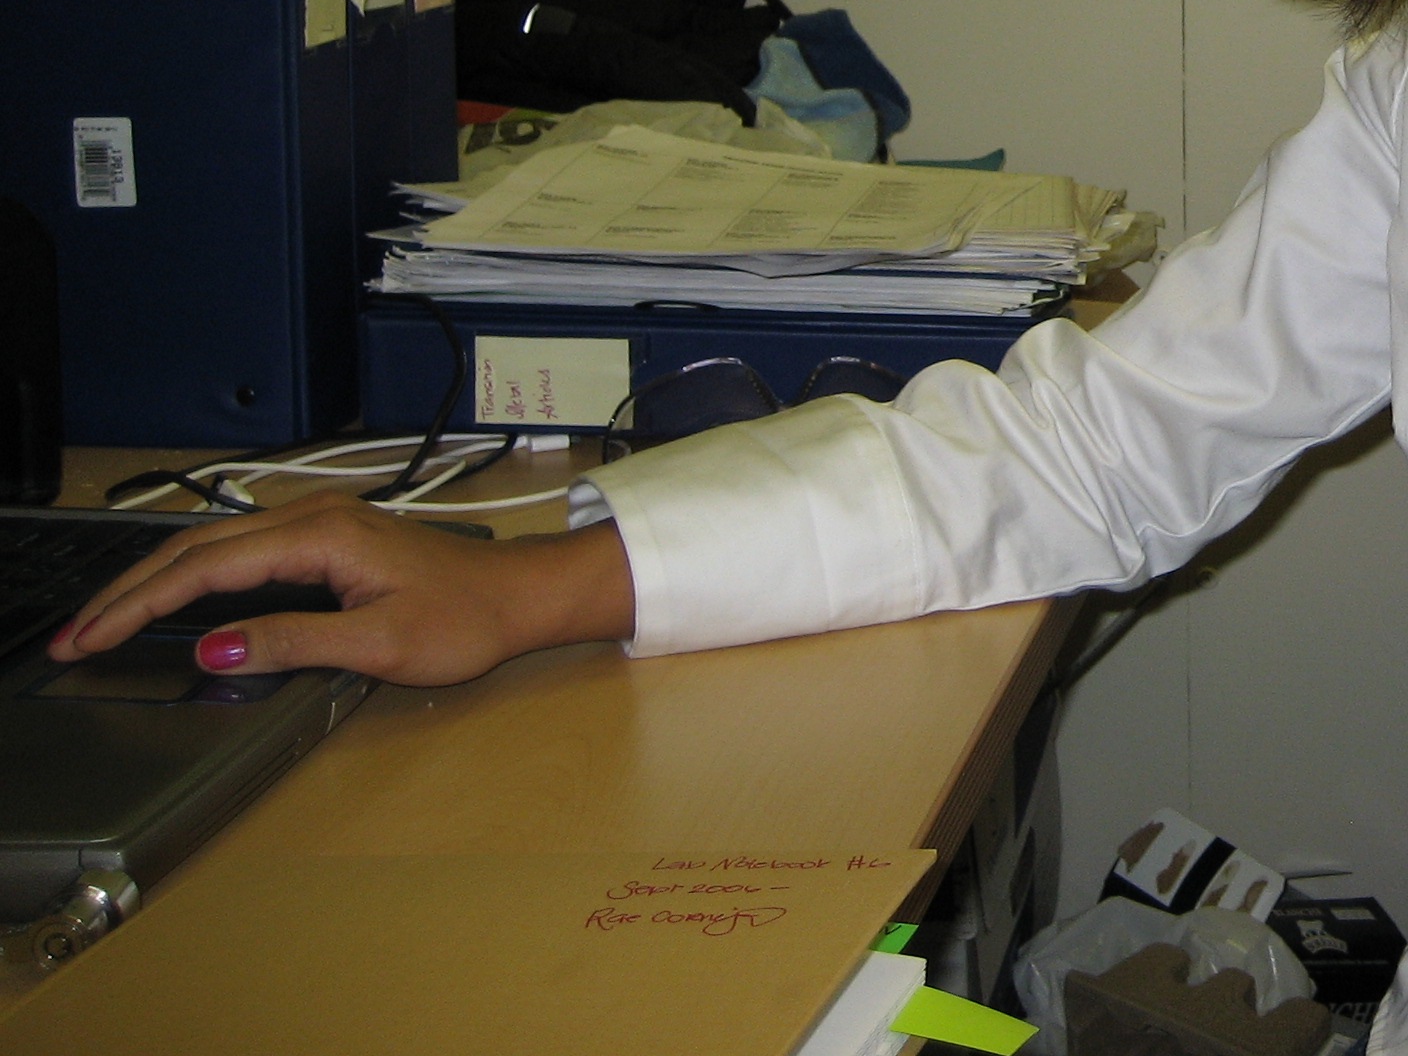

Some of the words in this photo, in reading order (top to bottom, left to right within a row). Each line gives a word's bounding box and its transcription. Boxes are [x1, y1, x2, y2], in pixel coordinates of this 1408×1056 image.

[651, 856, 706, 871] Lab
[709, 855, 832, 872] Notebook
[606, 880, 684, 901] Sept
